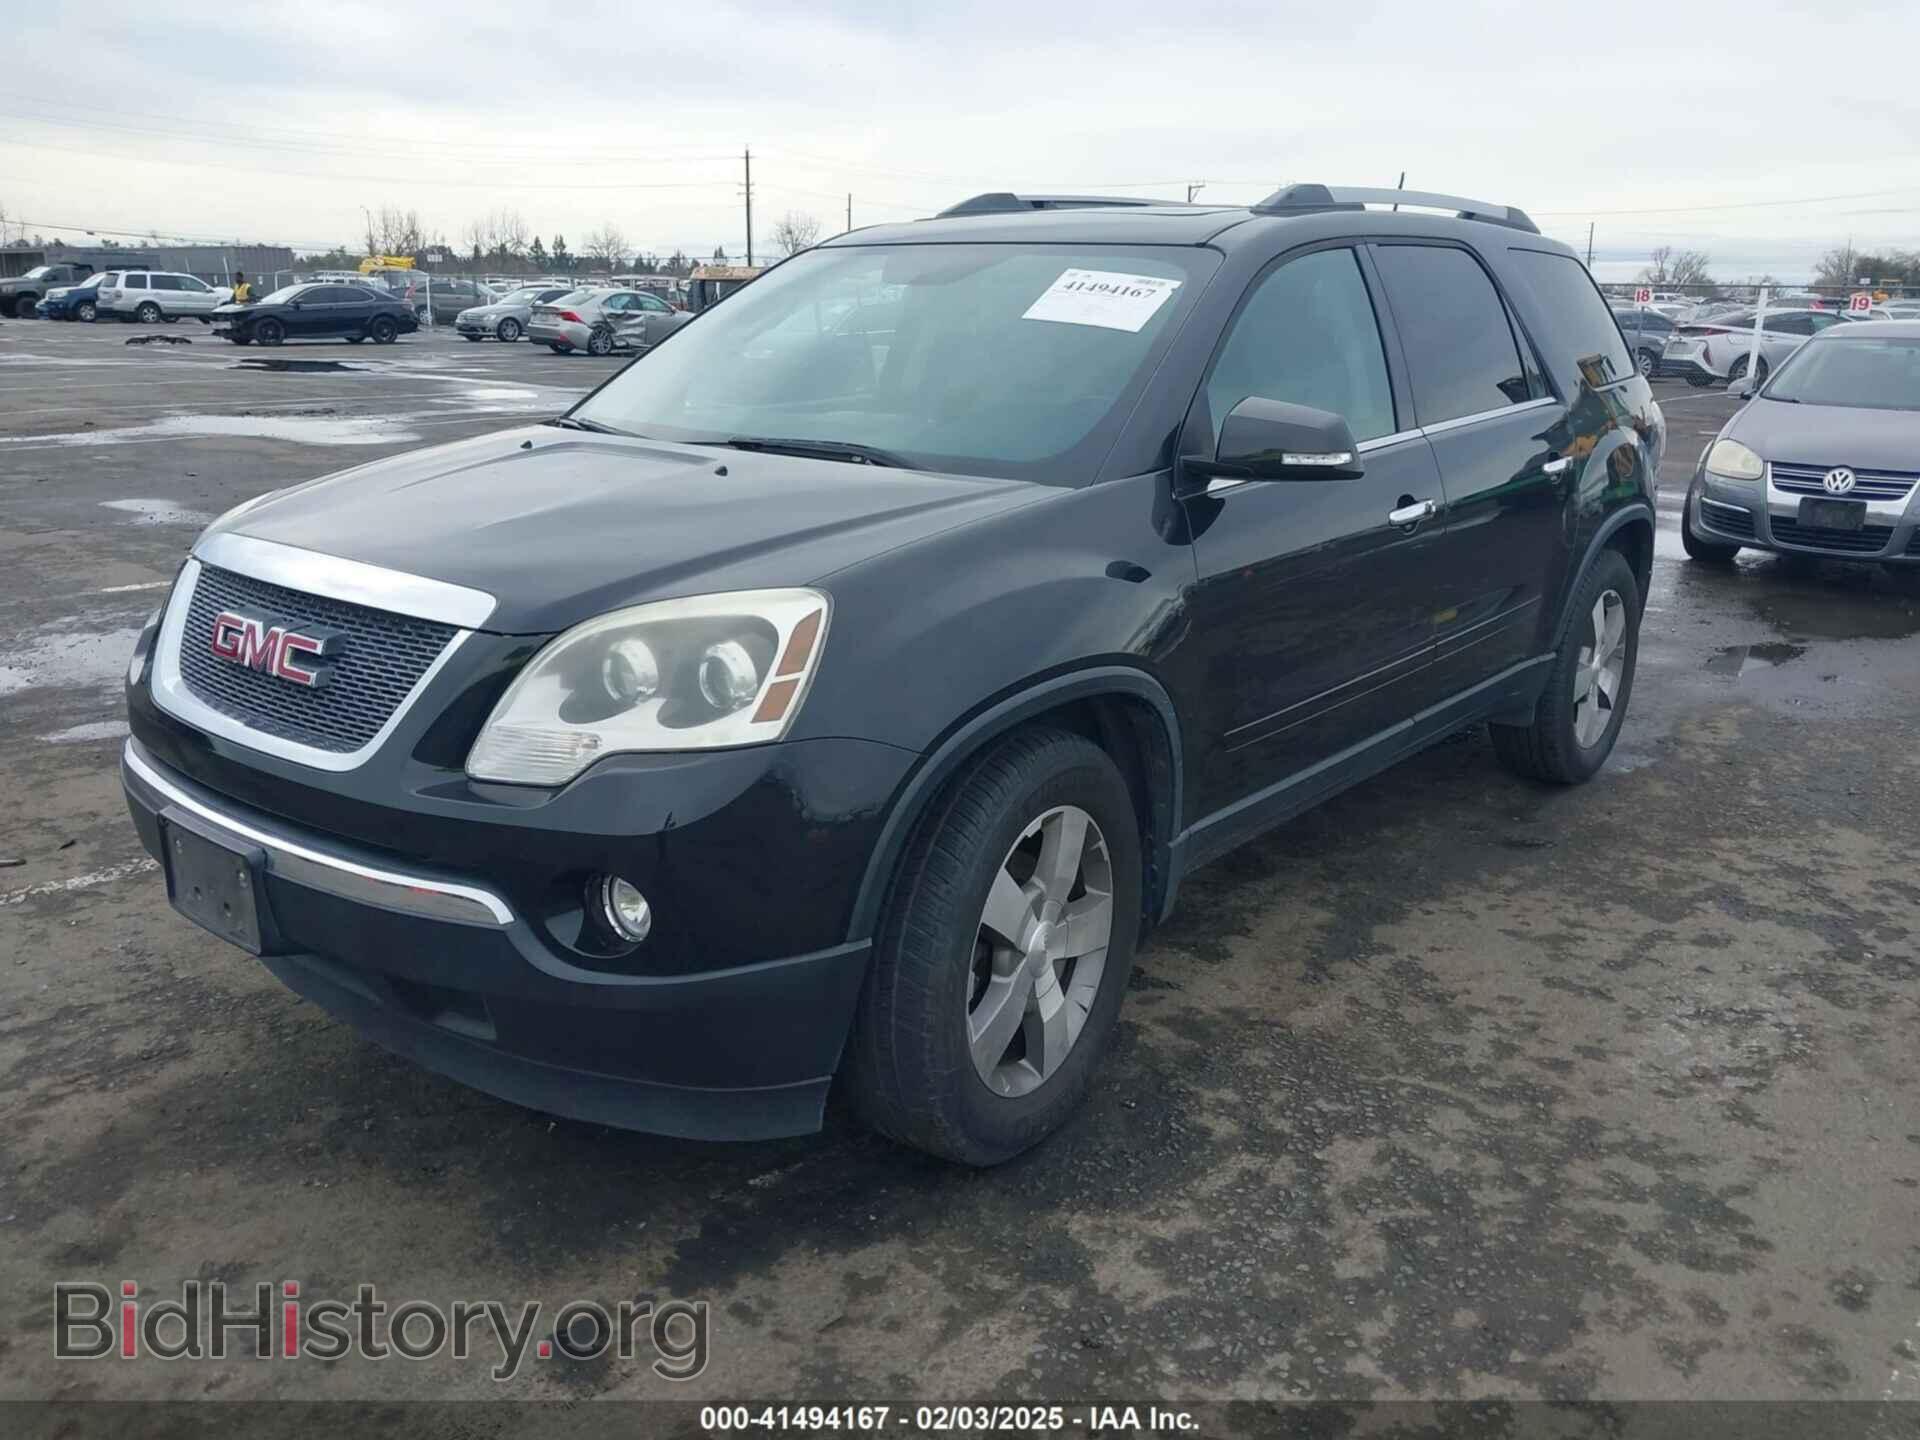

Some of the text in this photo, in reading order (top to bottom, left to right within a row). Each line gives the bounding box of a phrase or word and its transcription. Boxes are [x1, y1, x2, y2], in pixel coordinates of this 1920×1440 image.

[1063, 280, 1156, 298] 41494167
[1636, 290, 1650, 302] 18
[1852, 296, 1870, 311] 19
[211, 611, 324, 688] GMC
